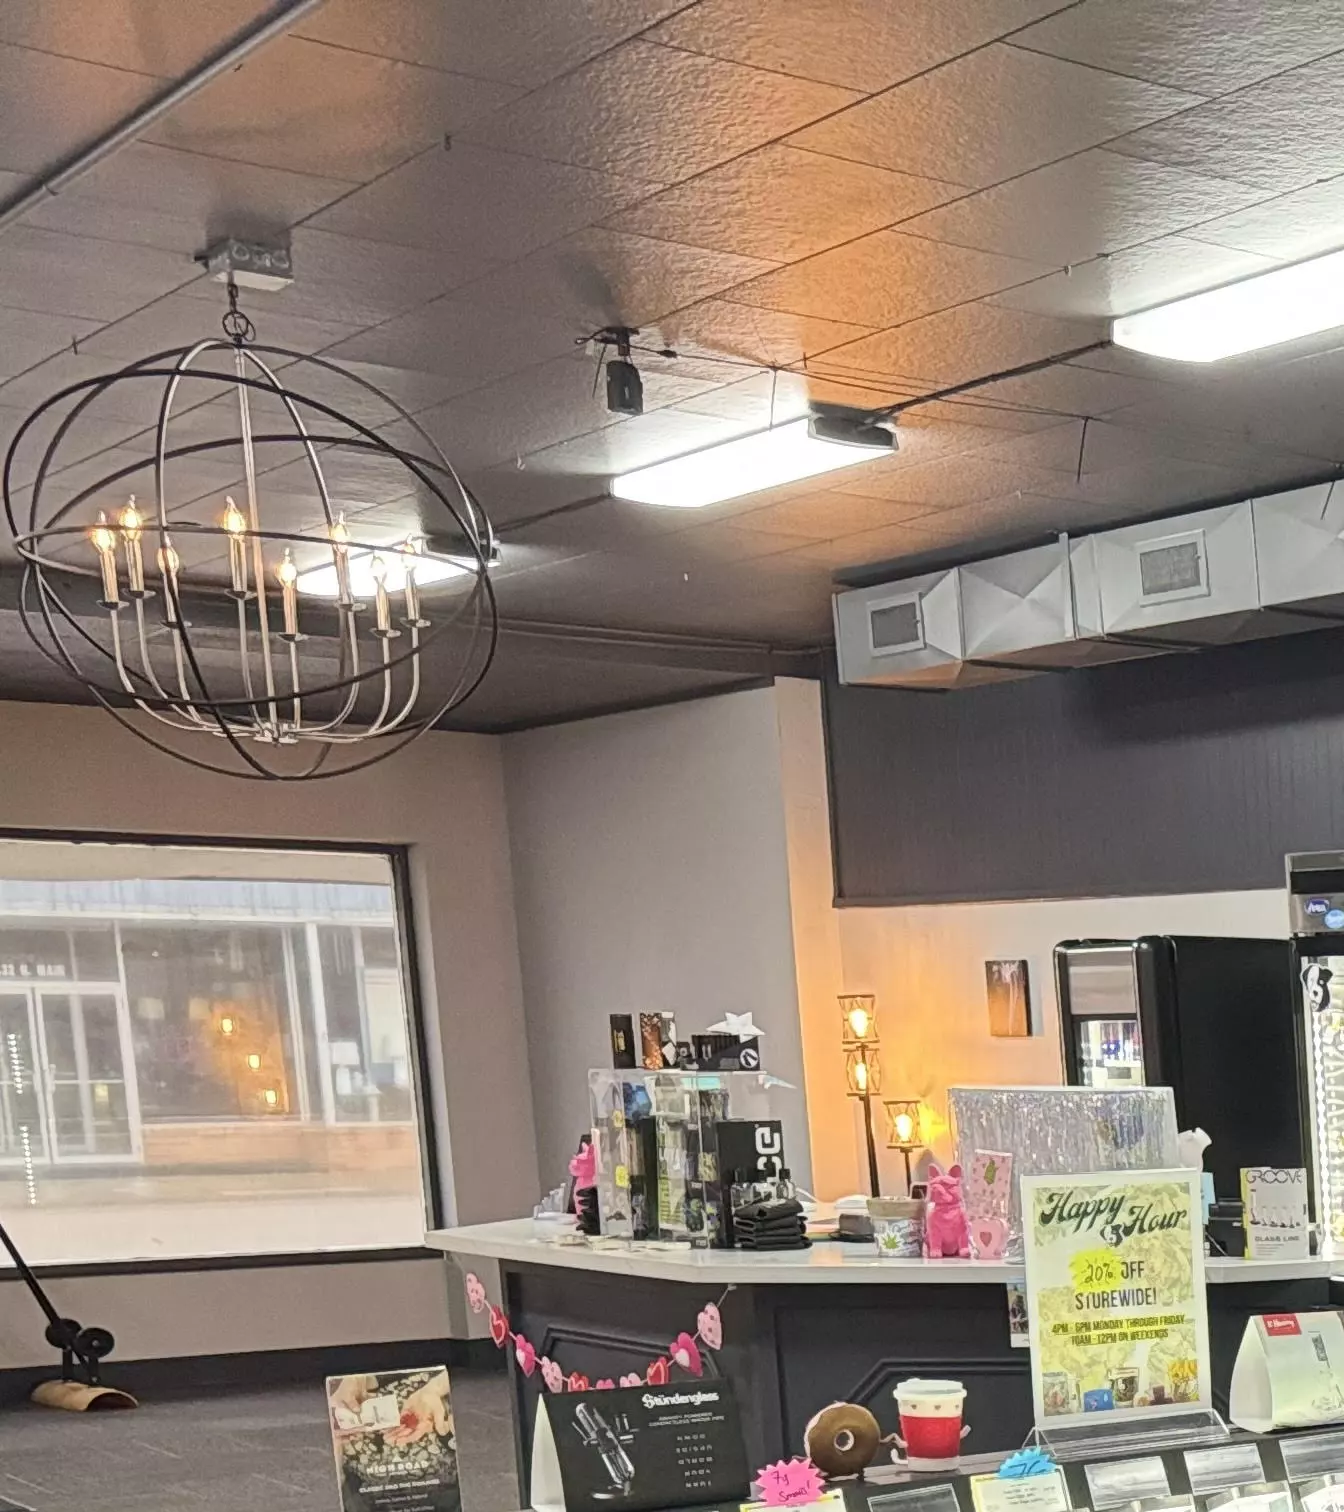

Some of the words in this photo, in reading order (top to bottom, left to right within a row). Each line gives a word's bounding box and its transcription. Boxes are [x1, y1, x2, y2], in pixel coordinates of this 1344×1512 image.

[1245, 1169, 1303, 1184] GROOVE
[1040, 1190, 1126, 1233] Happy
[1122, 1203, 1187, 1237] Hour
[1084, 1263, 1113, 1283] 20%
[1121, 1261, 1145, 1279] OFF
[1092, 1320, 1124, 1331] MONDAY
[1126, 1317, 1159, 1328] THROUGH
[1159, 1315, 1185, 1326] FRIDAY
